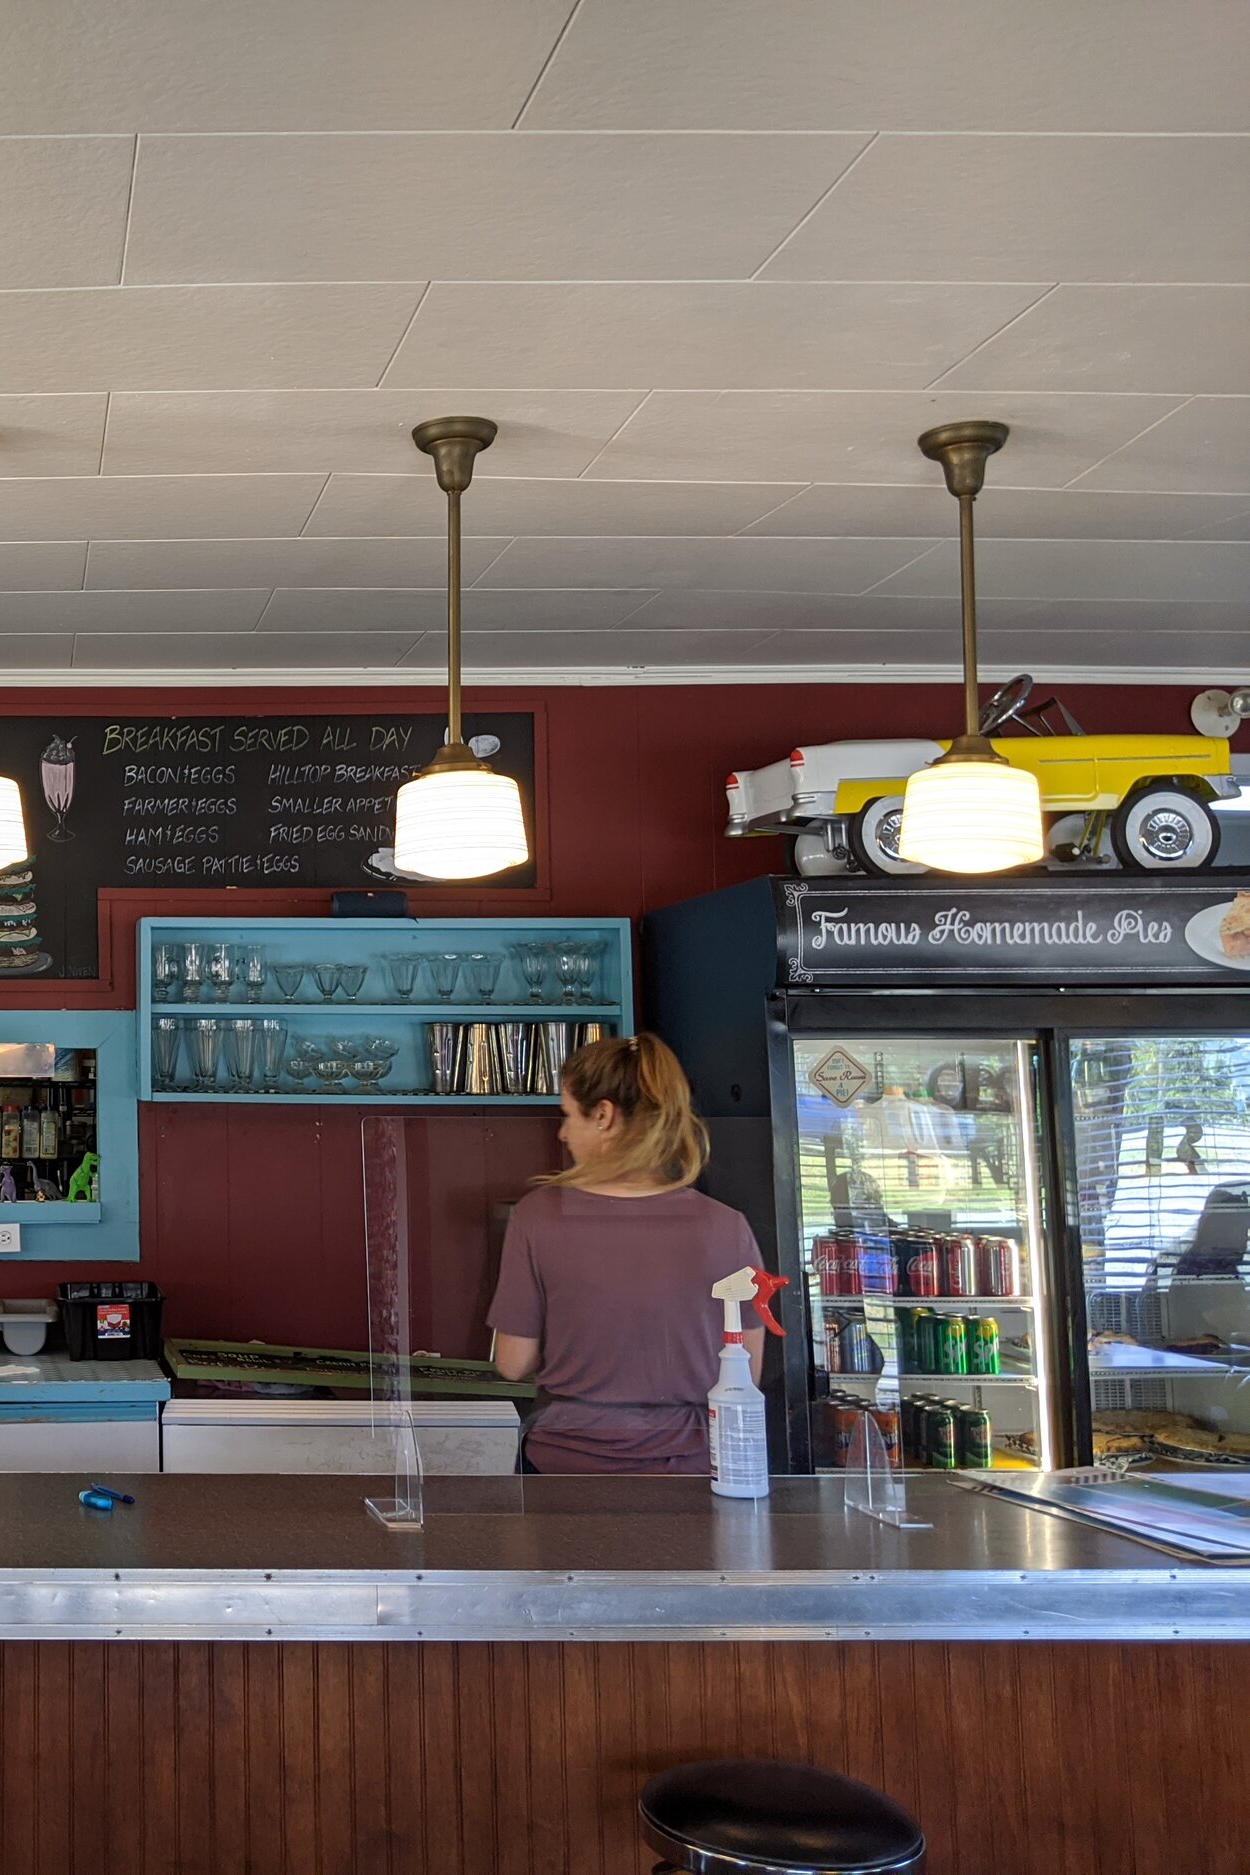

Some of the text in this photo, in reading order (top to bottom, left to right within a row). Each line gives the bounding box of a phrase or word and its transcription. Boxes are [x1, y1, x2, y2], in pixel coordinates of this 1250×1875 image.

[103, 725, 413, 755] BREAKFAST SERVED ALL DAY
[124, 765, 181, 786] BACON
[191, 766, 235, 784] EGGS
[268, 763, 421, 785] HILLTOP BREAKFAST
[123, 797, 189, 816] FARMER
[196, 798, 237, 816] EGGS
[268, 796, 396, 814] SMALLER APPET
[125, 826, 163, 846] HAM
[173, 825, 219, 844] EGGS
[269, 823, 314, 844] FRIED
[316, 825, 345, 844] EGG
[124, 856, 196, 875] SAUSAGE
[263, 853, 300, 875] EGGS
[812, 907, 1172, 949] Famous Homemade Pies
[814, 1070, 867, 1082] Save Room
